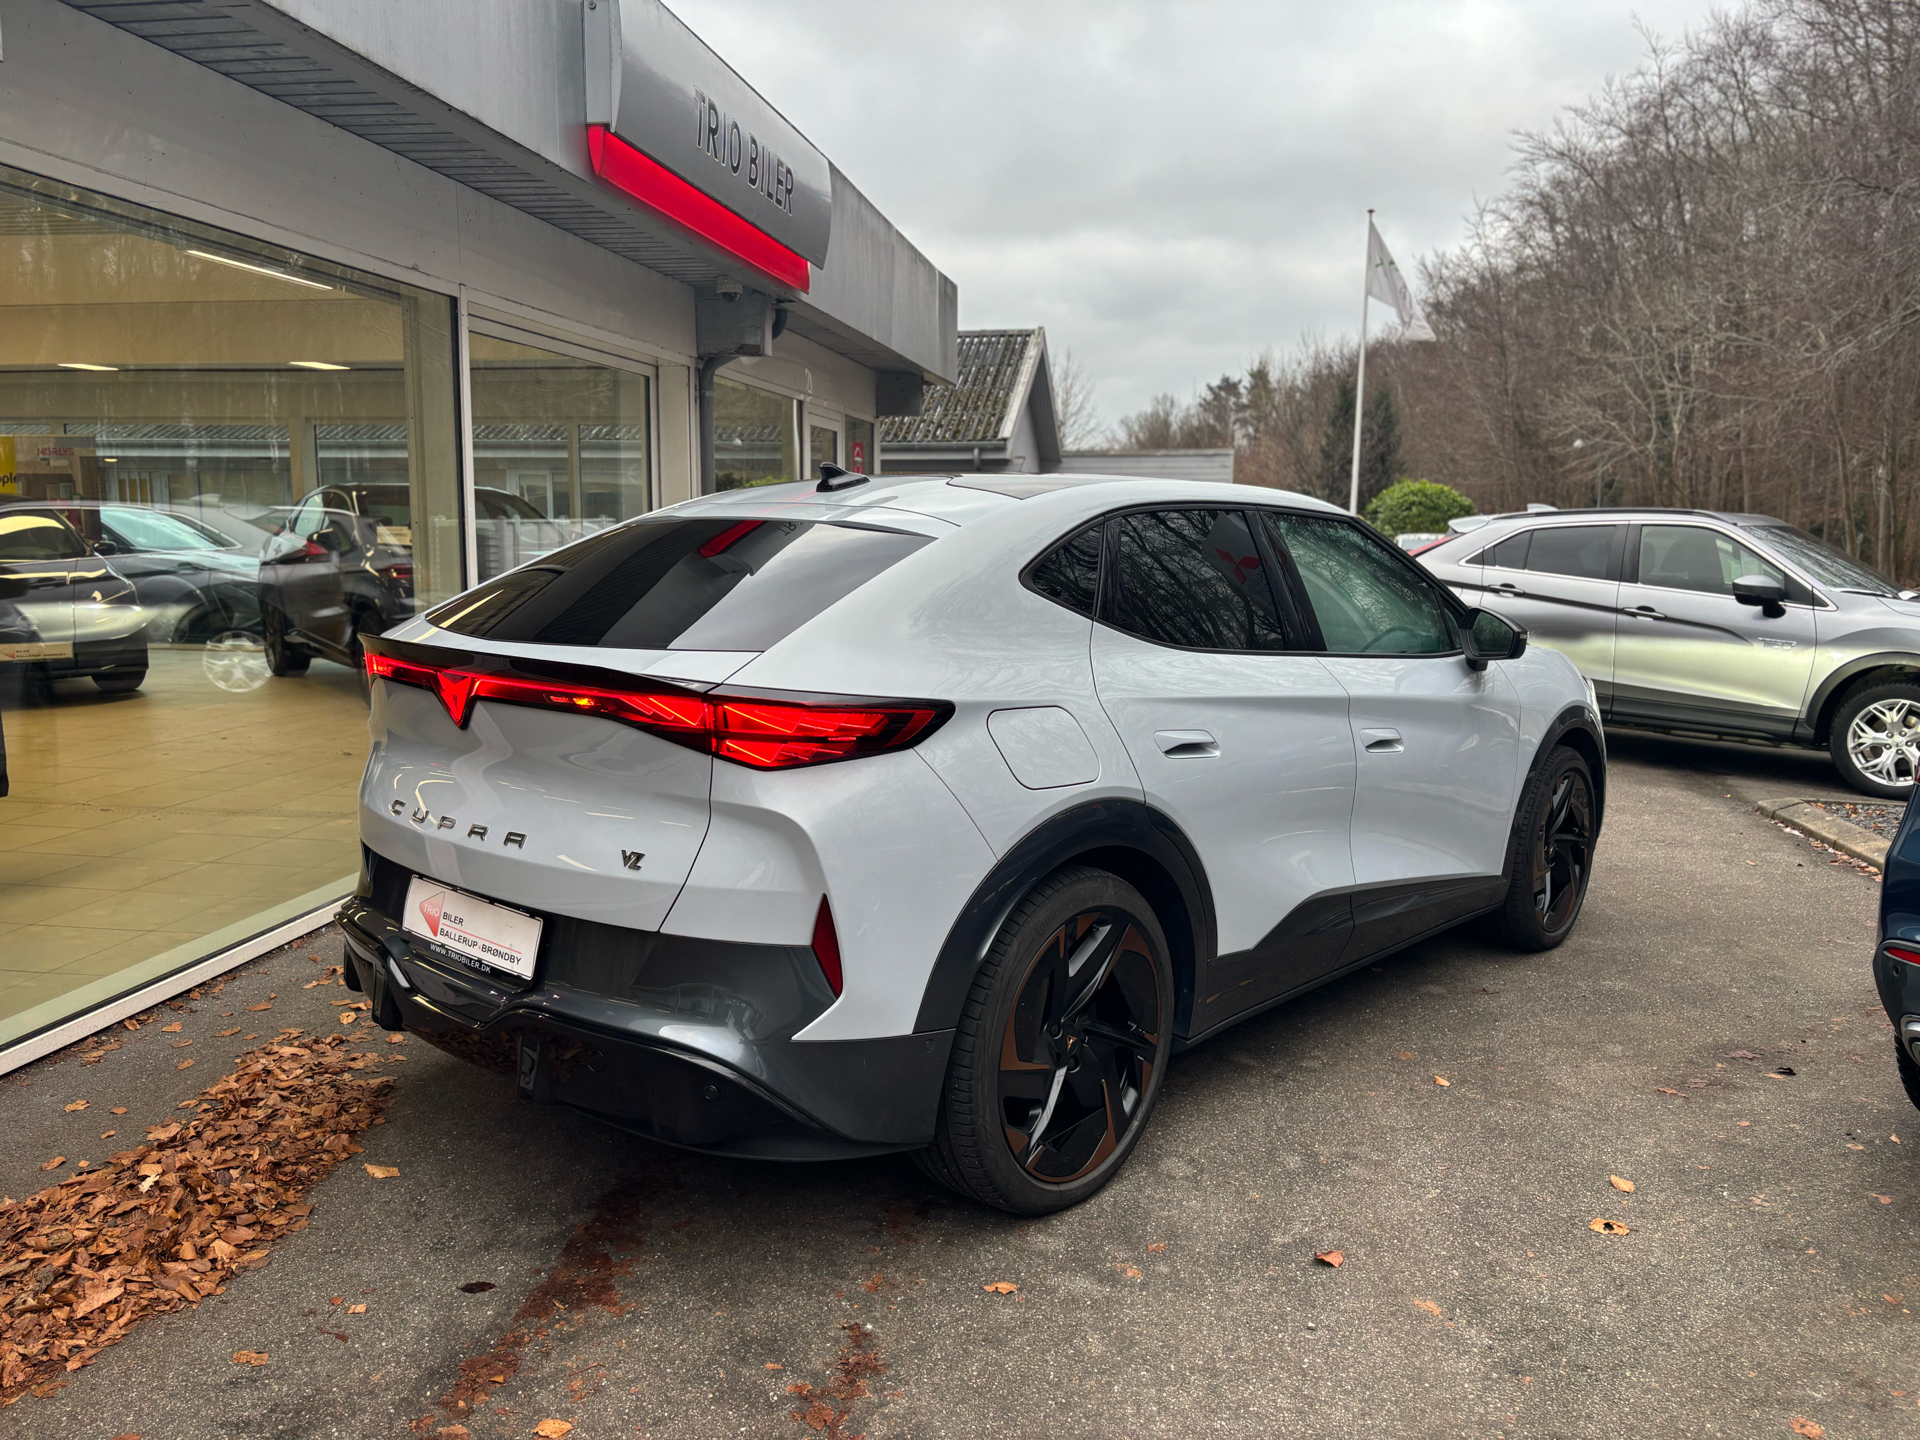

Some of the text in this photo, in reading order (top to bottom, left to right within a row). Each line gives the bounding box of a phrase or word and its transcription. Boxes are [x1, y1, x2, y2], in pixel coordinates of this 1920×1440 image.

[694, 85, 794, 216] TRIO BILER
[37, 447, 75, 456] NORLYS
[391, 799, 529, 850] CUPRA
[621, 849, 646, 871] VZ
[423, 903, 440, 917] TRIO
[442, 911, 464, 927] BILER
[430, 943, 492, 975] WWW.TRIOBILER.DK
[439, 927, 522, 966] BALLERUP BRØNDBY
